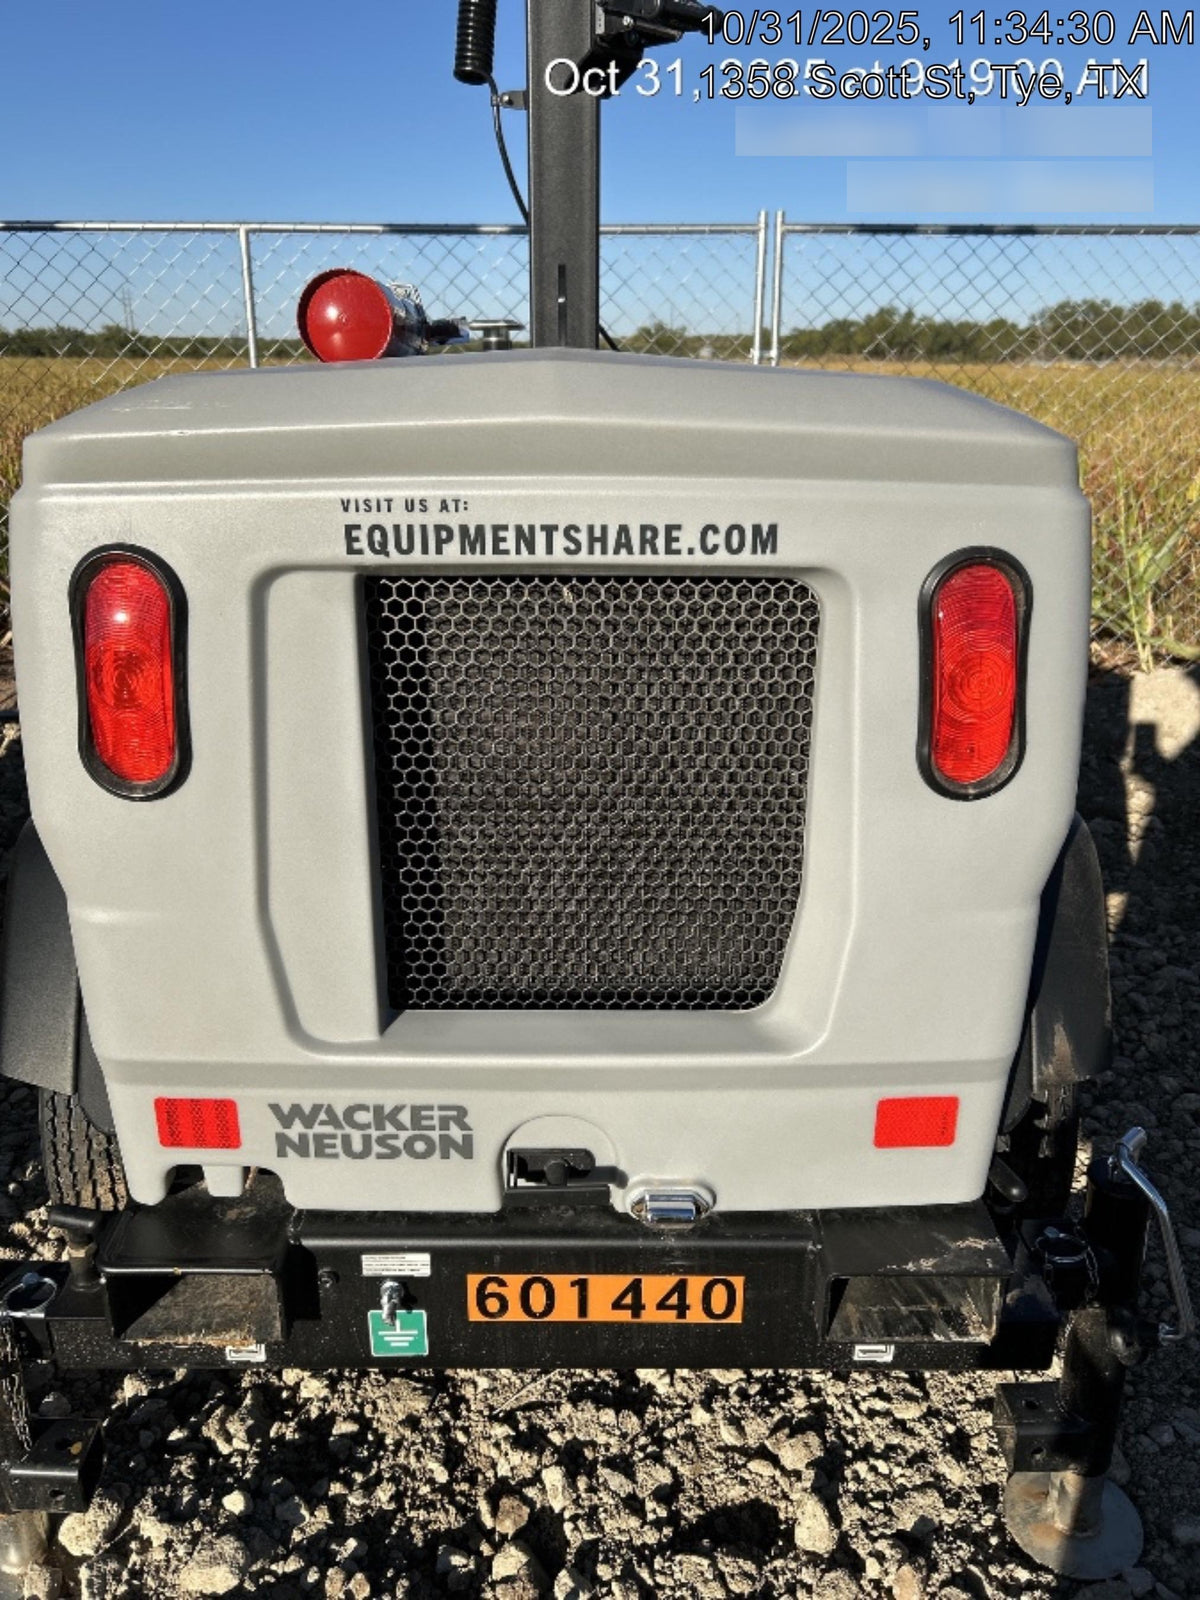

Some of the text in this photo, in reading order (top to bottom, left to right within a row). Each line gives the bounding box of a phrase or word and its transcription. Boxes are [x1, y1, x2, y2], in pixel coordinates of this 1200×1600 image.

[340, 498, 468, 513] VISIT US AT:
[344, 523, 779, 558] EQUIPMENTSHARE.COM
[268, 1103, 474, 1131] WACKER
[275, 1132, 474, 1160] NEUSON
[475, 1276, 738, 1320] 601440
